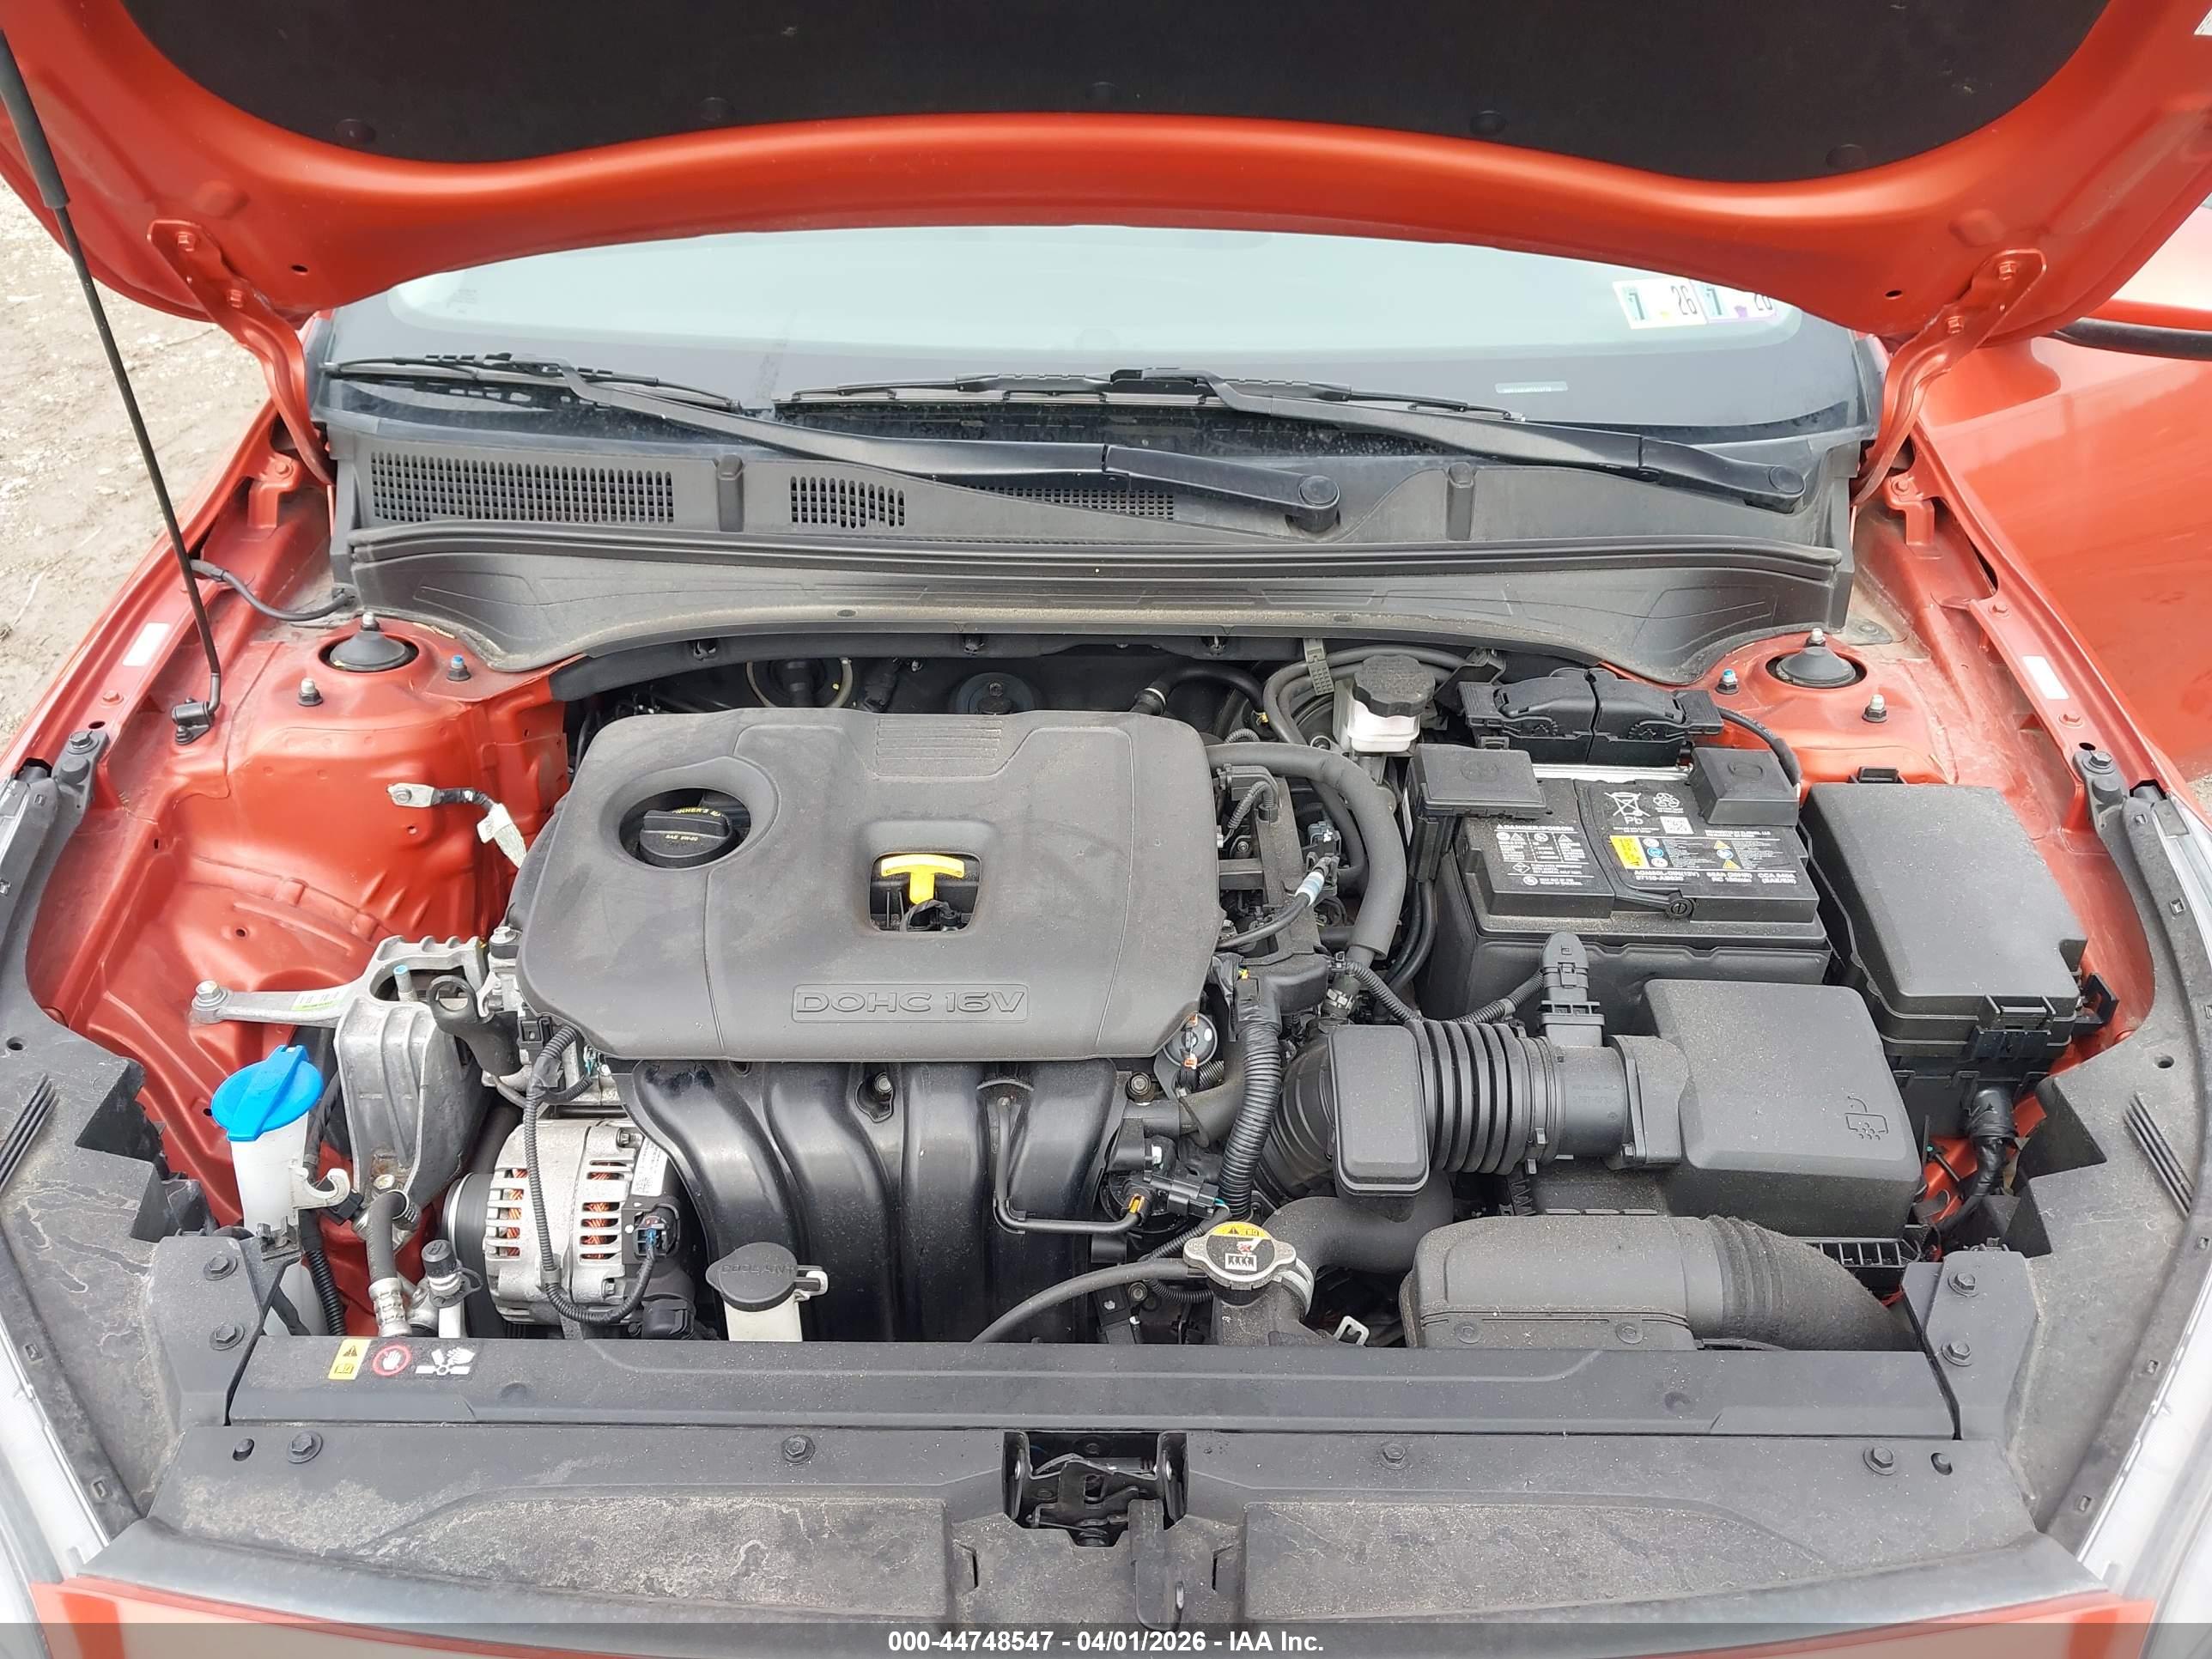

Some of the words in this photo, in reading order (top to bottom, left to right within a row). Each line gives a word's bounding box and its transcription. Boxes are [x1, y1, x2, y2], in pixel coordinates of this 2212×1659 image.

[1671, 285, 1698, 315] 26
[1625, 816, 1644, 825] Pb
[796, 991, 933, 1013] DOHC
[945, 991, 1025, 1013] 16V
